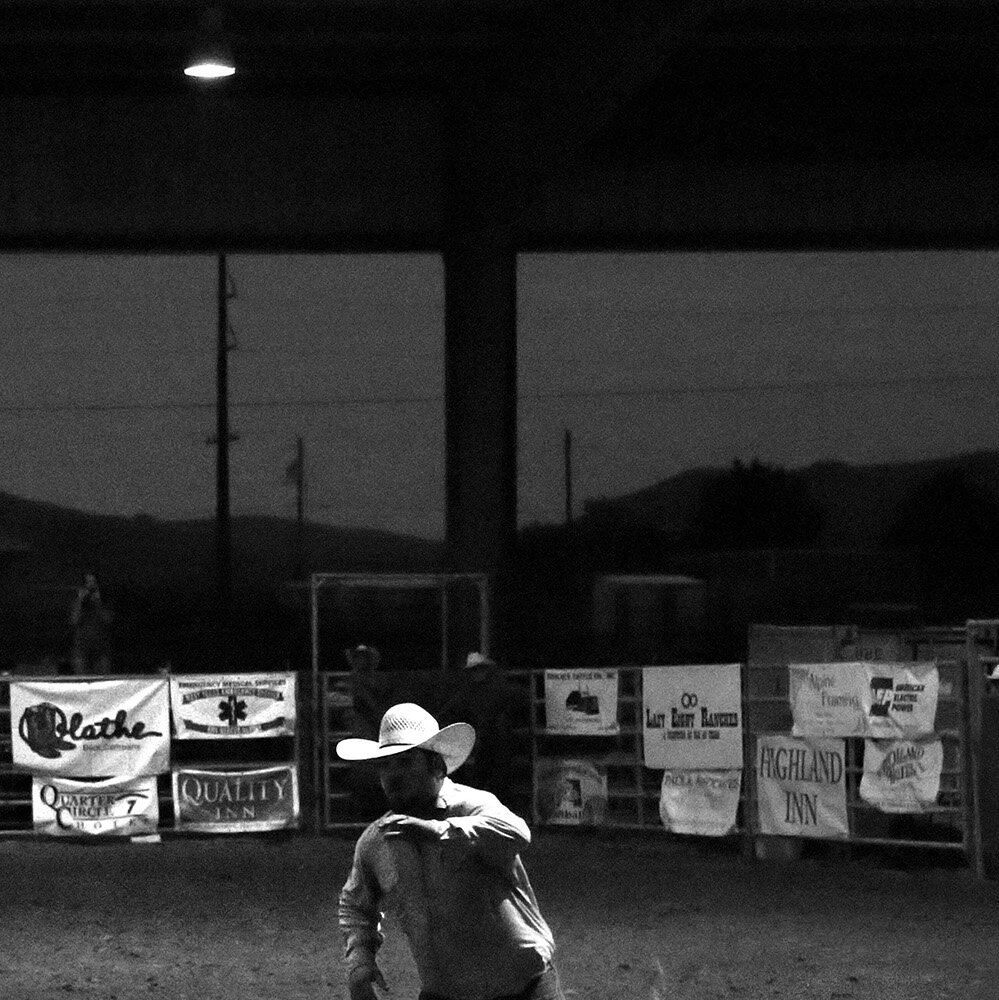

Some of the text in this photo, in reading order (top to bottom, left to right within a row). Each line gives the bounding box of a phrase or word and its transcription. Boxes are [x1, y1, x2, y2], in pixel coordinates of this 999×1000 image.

[759, 747, 843, 785] HIGHLAND
[40, 784, 116, 810] QUARTER
[181, 778, 288, 806] QUALITY
[56, 800, 137, 828] CIRCLE 7
[215, 805, 255, 820] INN
[784, 790, 818, 826] INN
